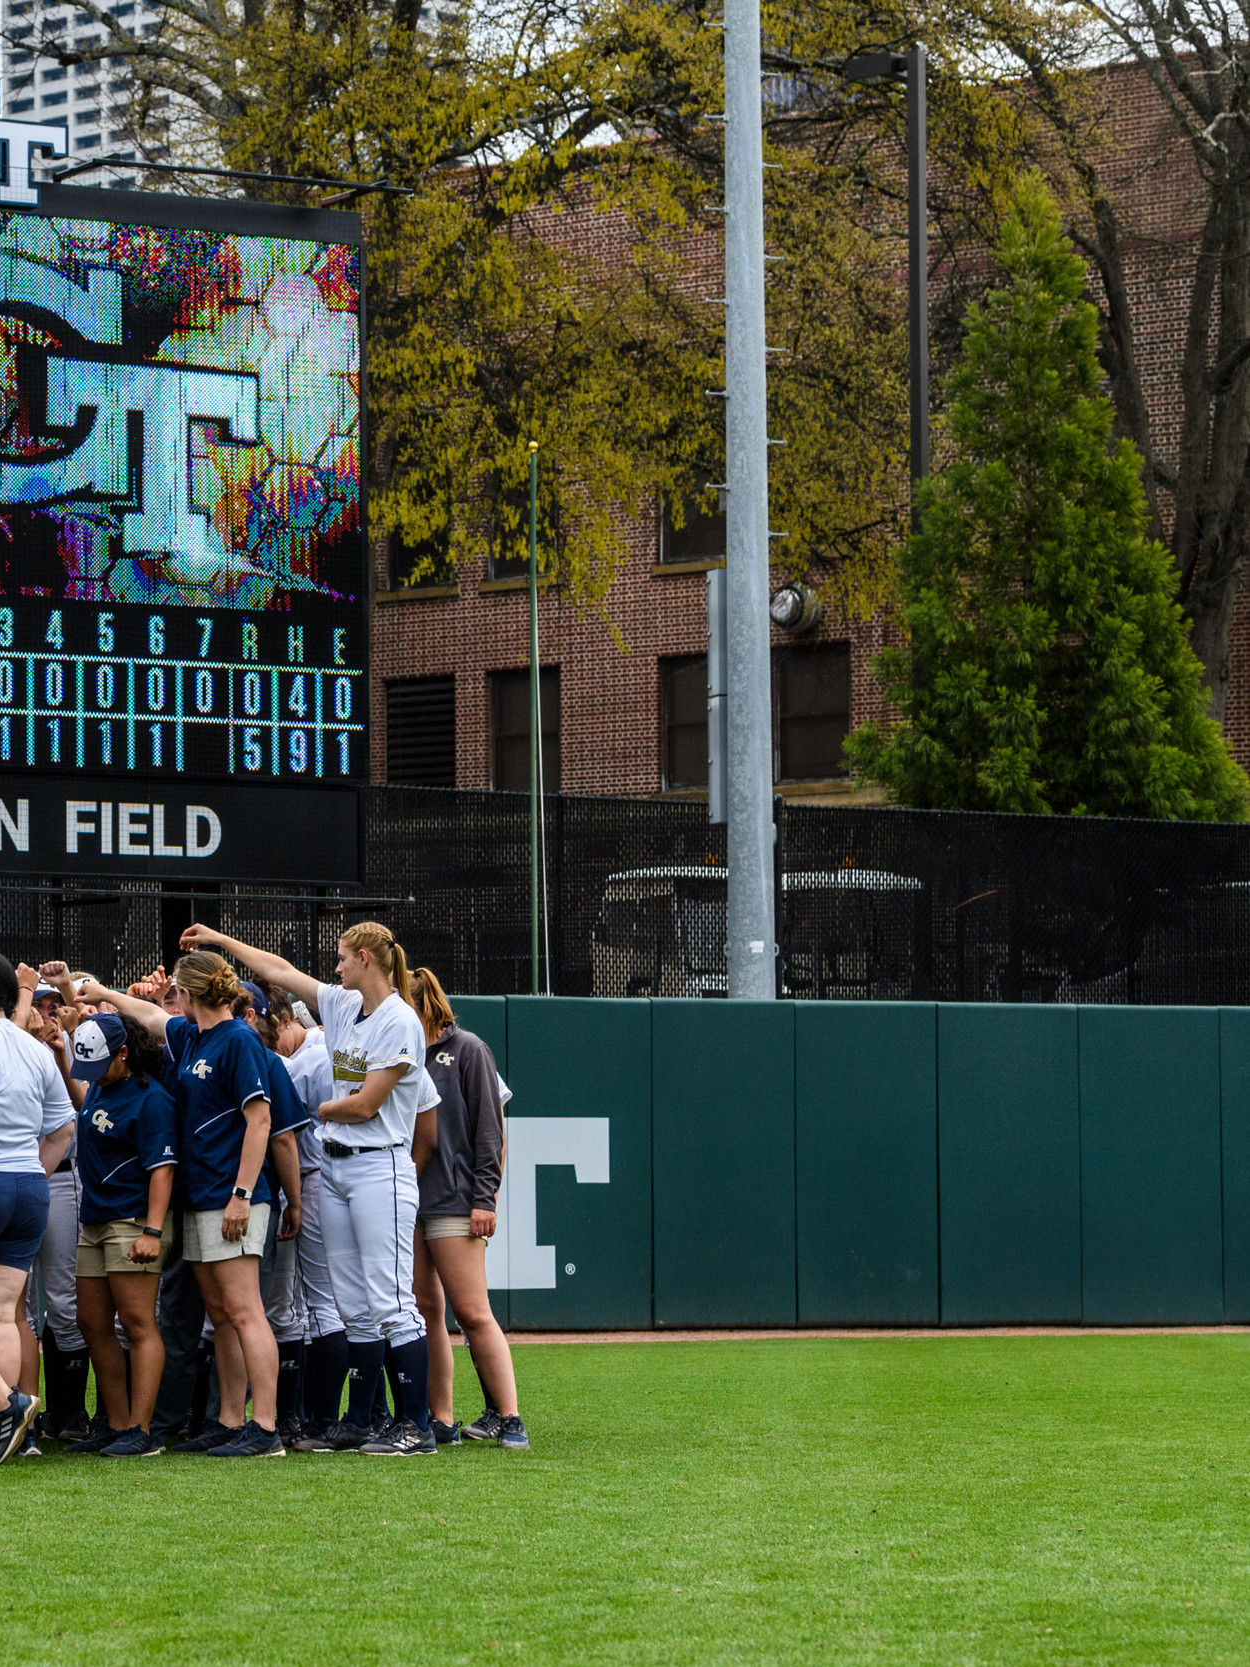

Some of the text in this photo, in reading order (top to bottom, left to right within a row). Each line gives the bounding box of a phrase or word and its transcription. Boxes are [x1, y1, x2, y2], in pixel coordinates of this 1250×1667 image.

[45, 610, 64, 649] 4
[97, 612, 115, 652] 5
[148, 615, 165, 655] 6
[196, 618, 213, 657] 7
[241, 622, 258, 660] R
[288, 625, 304, 662] H
[332, 628, 347, 664] E
[45, 662, 64, 706] 0
[96, 664, 115, 708] 0
[147, 667, 165, 711] 0
[195, 669, 214, 713] 0
[243, 672, 261, 715] 0
[288, 674, 307, 718] 4
[334, 676, 352, 720] 0
[47, 719, 60, 763] 1
[98, 721, 112, 765] 1
[149, 723, 162, 767] 1
[243, 727, 262, 771] 5
[289, 729, 307, 773] 9
[336, 731, 350, 775] 1
[65, 800, 222, 857] FIELD
[75, 1042, 94, 1059] GT
[192, 1059, 212, 1079] GT
[435, 1052, 455, 1066] GT
[92, 1110, 114, 1133] GT
